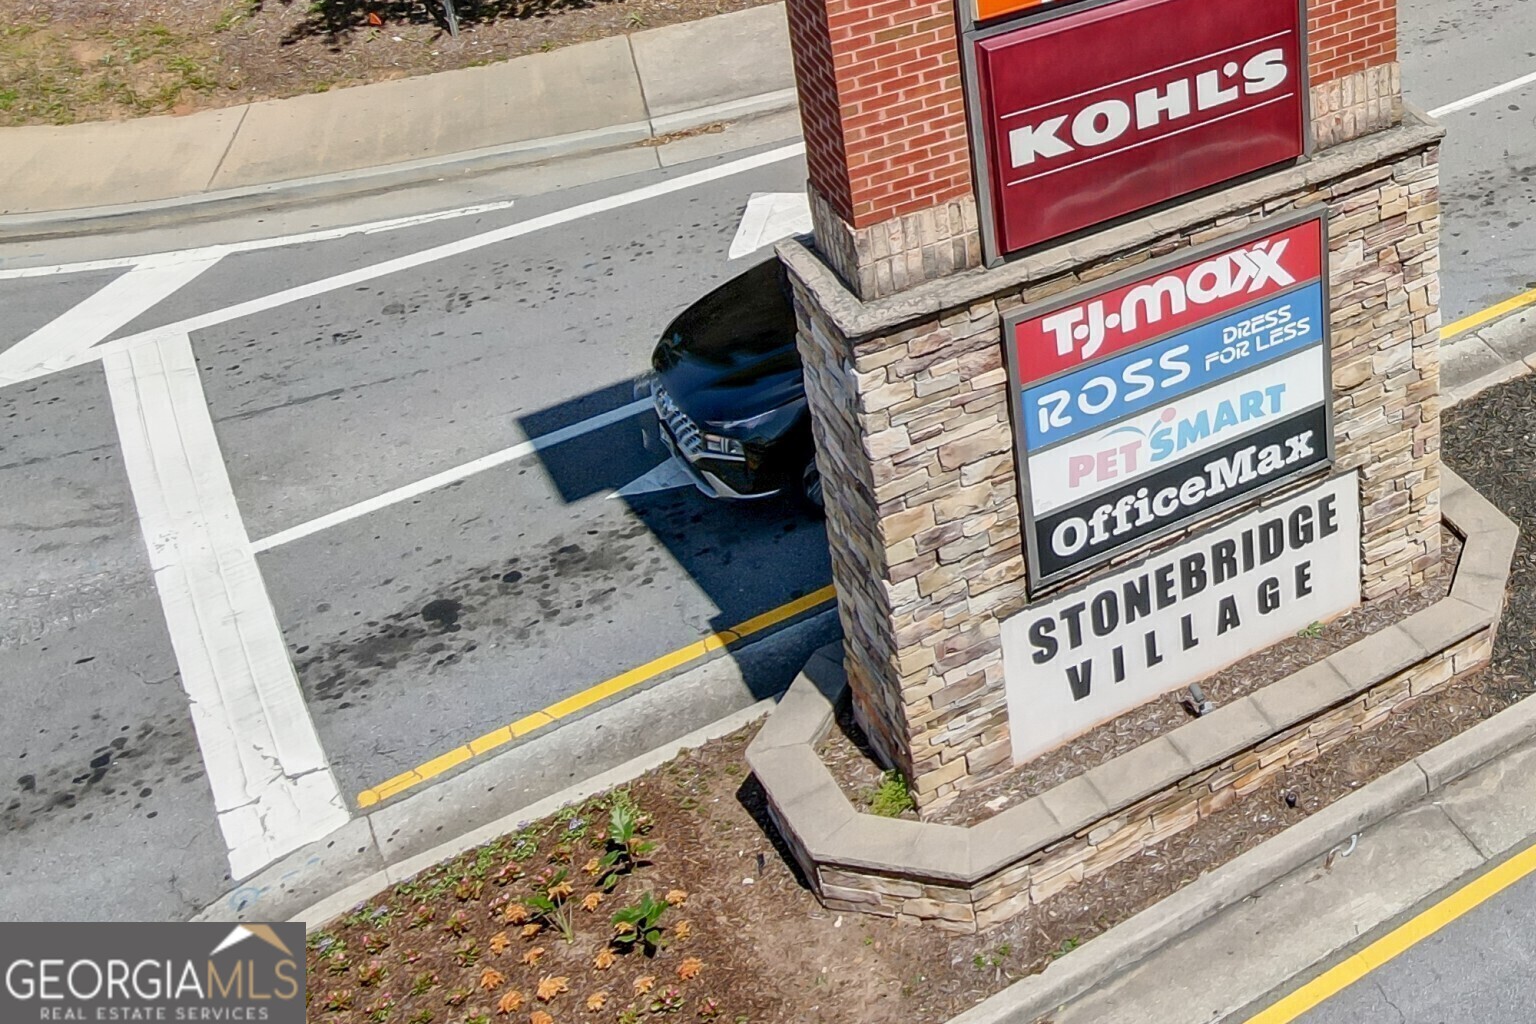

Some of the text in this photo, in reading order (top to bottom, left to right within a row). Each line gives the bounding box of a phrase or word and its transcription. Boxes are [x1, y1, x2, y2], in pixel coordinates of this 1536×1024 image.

[1008, 48, 1288, 169] KOHL'S
[1204, 317, 1311, 372] FOR LESS
[1222, 304, 1292, 345] DRESS
[1036, 344, 1191, 433] ROSS
[1051, 429, 1315, 558] OfficeMax
[1028, 493, 1338, 665] STONEBRIDGE
[1065, 560, 1312, 702] VILLAGE
